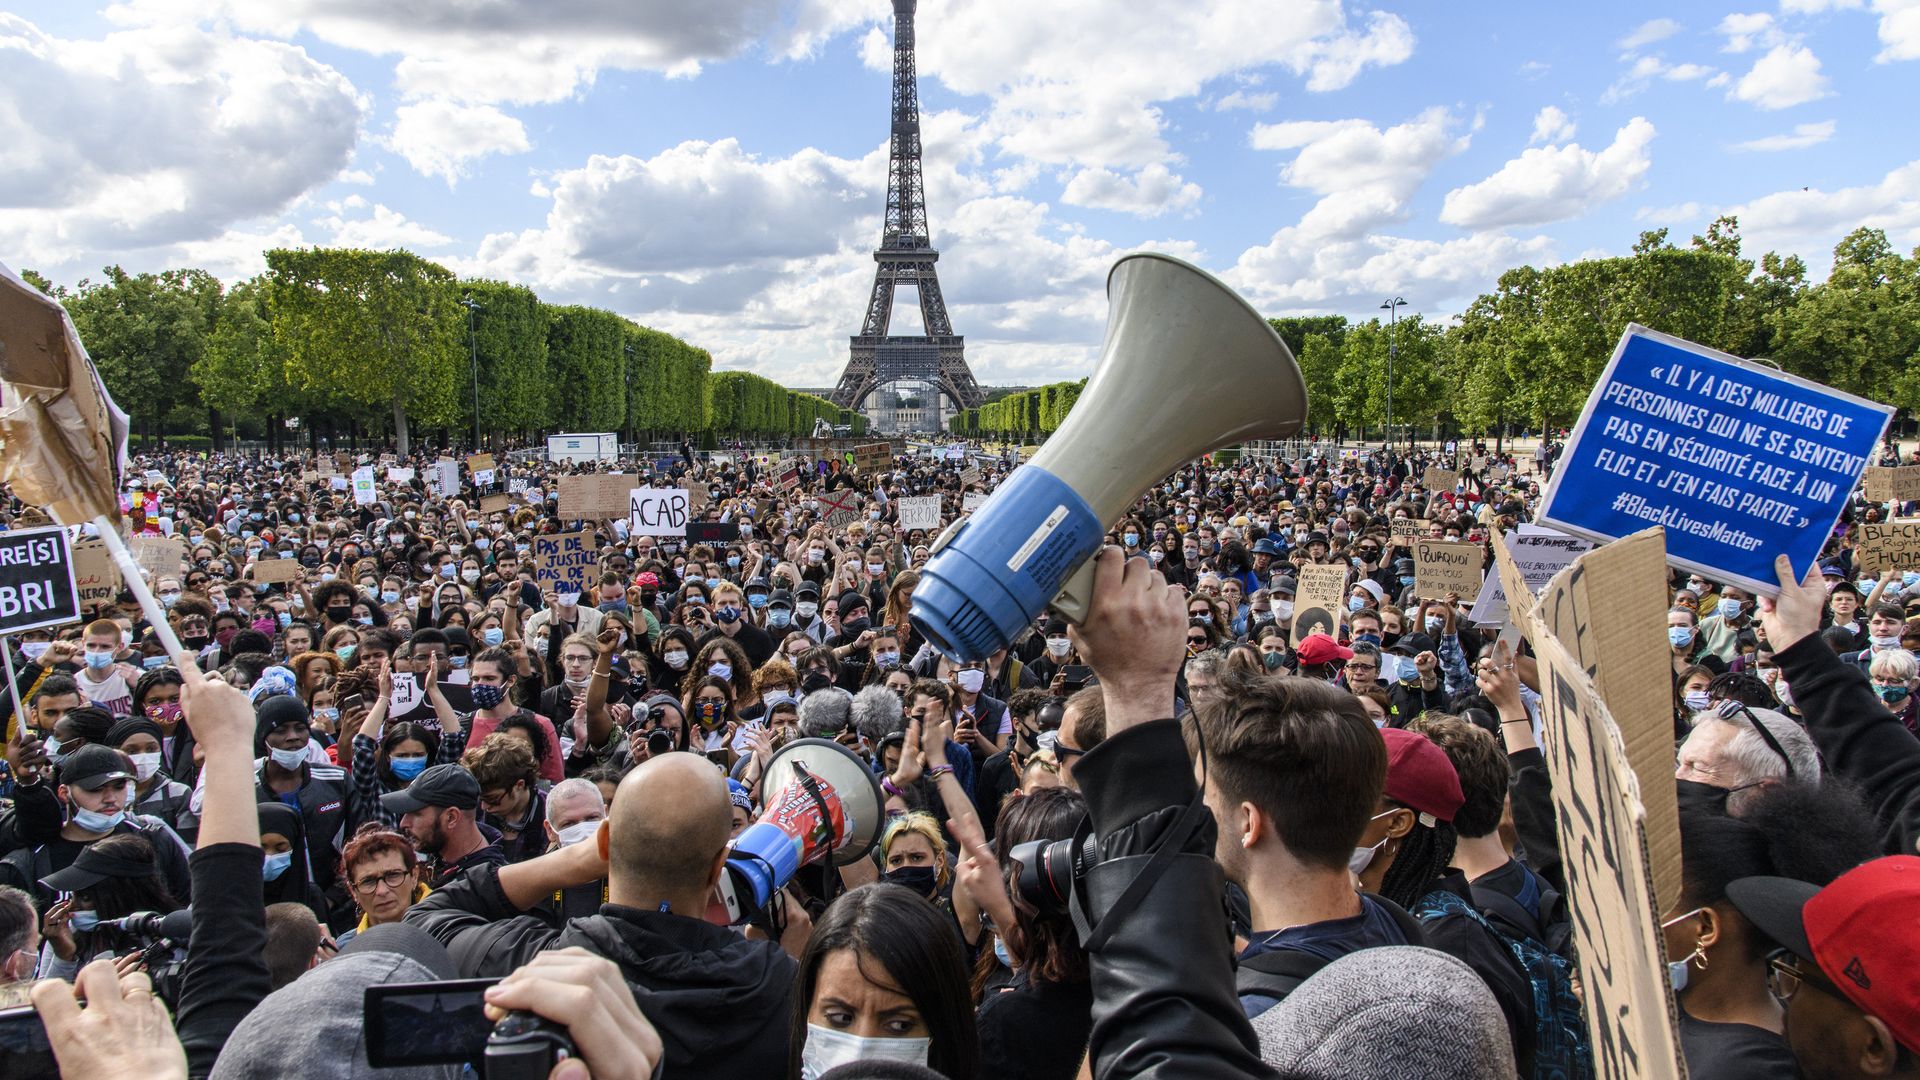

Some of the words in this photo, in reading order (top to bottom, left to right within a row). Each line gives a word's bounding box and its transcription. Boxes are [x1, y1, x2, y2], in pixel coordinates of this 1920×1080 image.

[1665, 364, 1680, 385] IL
[1688, 371, 1700, 390] Y
[1700, 375, 1712, 395] A
[1716, 379, 1752, 406] DES
[1750, 390, 1827, 429] MILLIERS
[1827, 413, 1852, 438] DE
[1604, 381, 1708, 429] PERSONNES
[1707, 412, 1737, 437] QUI
[1740, 424, 1765, 445] NE
[1764, 430, 1791, 453] SE
[1789, 440, 1864, 478] SENTENT
[1604, 416, 1642, 444] PAS
[1647, 428, 1669, 452] EN
[1668, 436, 1752, 478] SÉCURITÉ
[1748, 461, 1793, 491] FACE
[1793, 472, 1809, 495] À
[1809, 480, 1837, 503] UN
[1868, 468, 1891, 478] HOW
[1898, 468, 1920, 478] MAN
[1595, 448, 1631, 477] FLIC
[1635, 460, 1660, 483] ET
[1658, 466, 1700, 494] J'EN
[1699, 481, 1735, 508] FAIS
[1738, 494, 1800, 528] PARTIE
[631, 495, 686, 528] ACAB
[900, 506, 938, 524] TERROR
[1612, 491, 1763, 552] #BlackLivesMatter
[0, 537, 60, 567] RE[S]
[537, 539, 559, 555] PAS
[565, 537, 582, 551] DE
[1418, 545, 1469, 565] POURQUOI
[546, 550, 597, 568] JUSTICE
[1879, 552, 1920, 564] HUMA
[538, 568, 560, 580] PAS
[568, 566, 584, 579] DE
[78, 586, 112, 600] NERGY
[554, 579, 584, 594] PAIX
[320, 802, 340, 811] adidas
